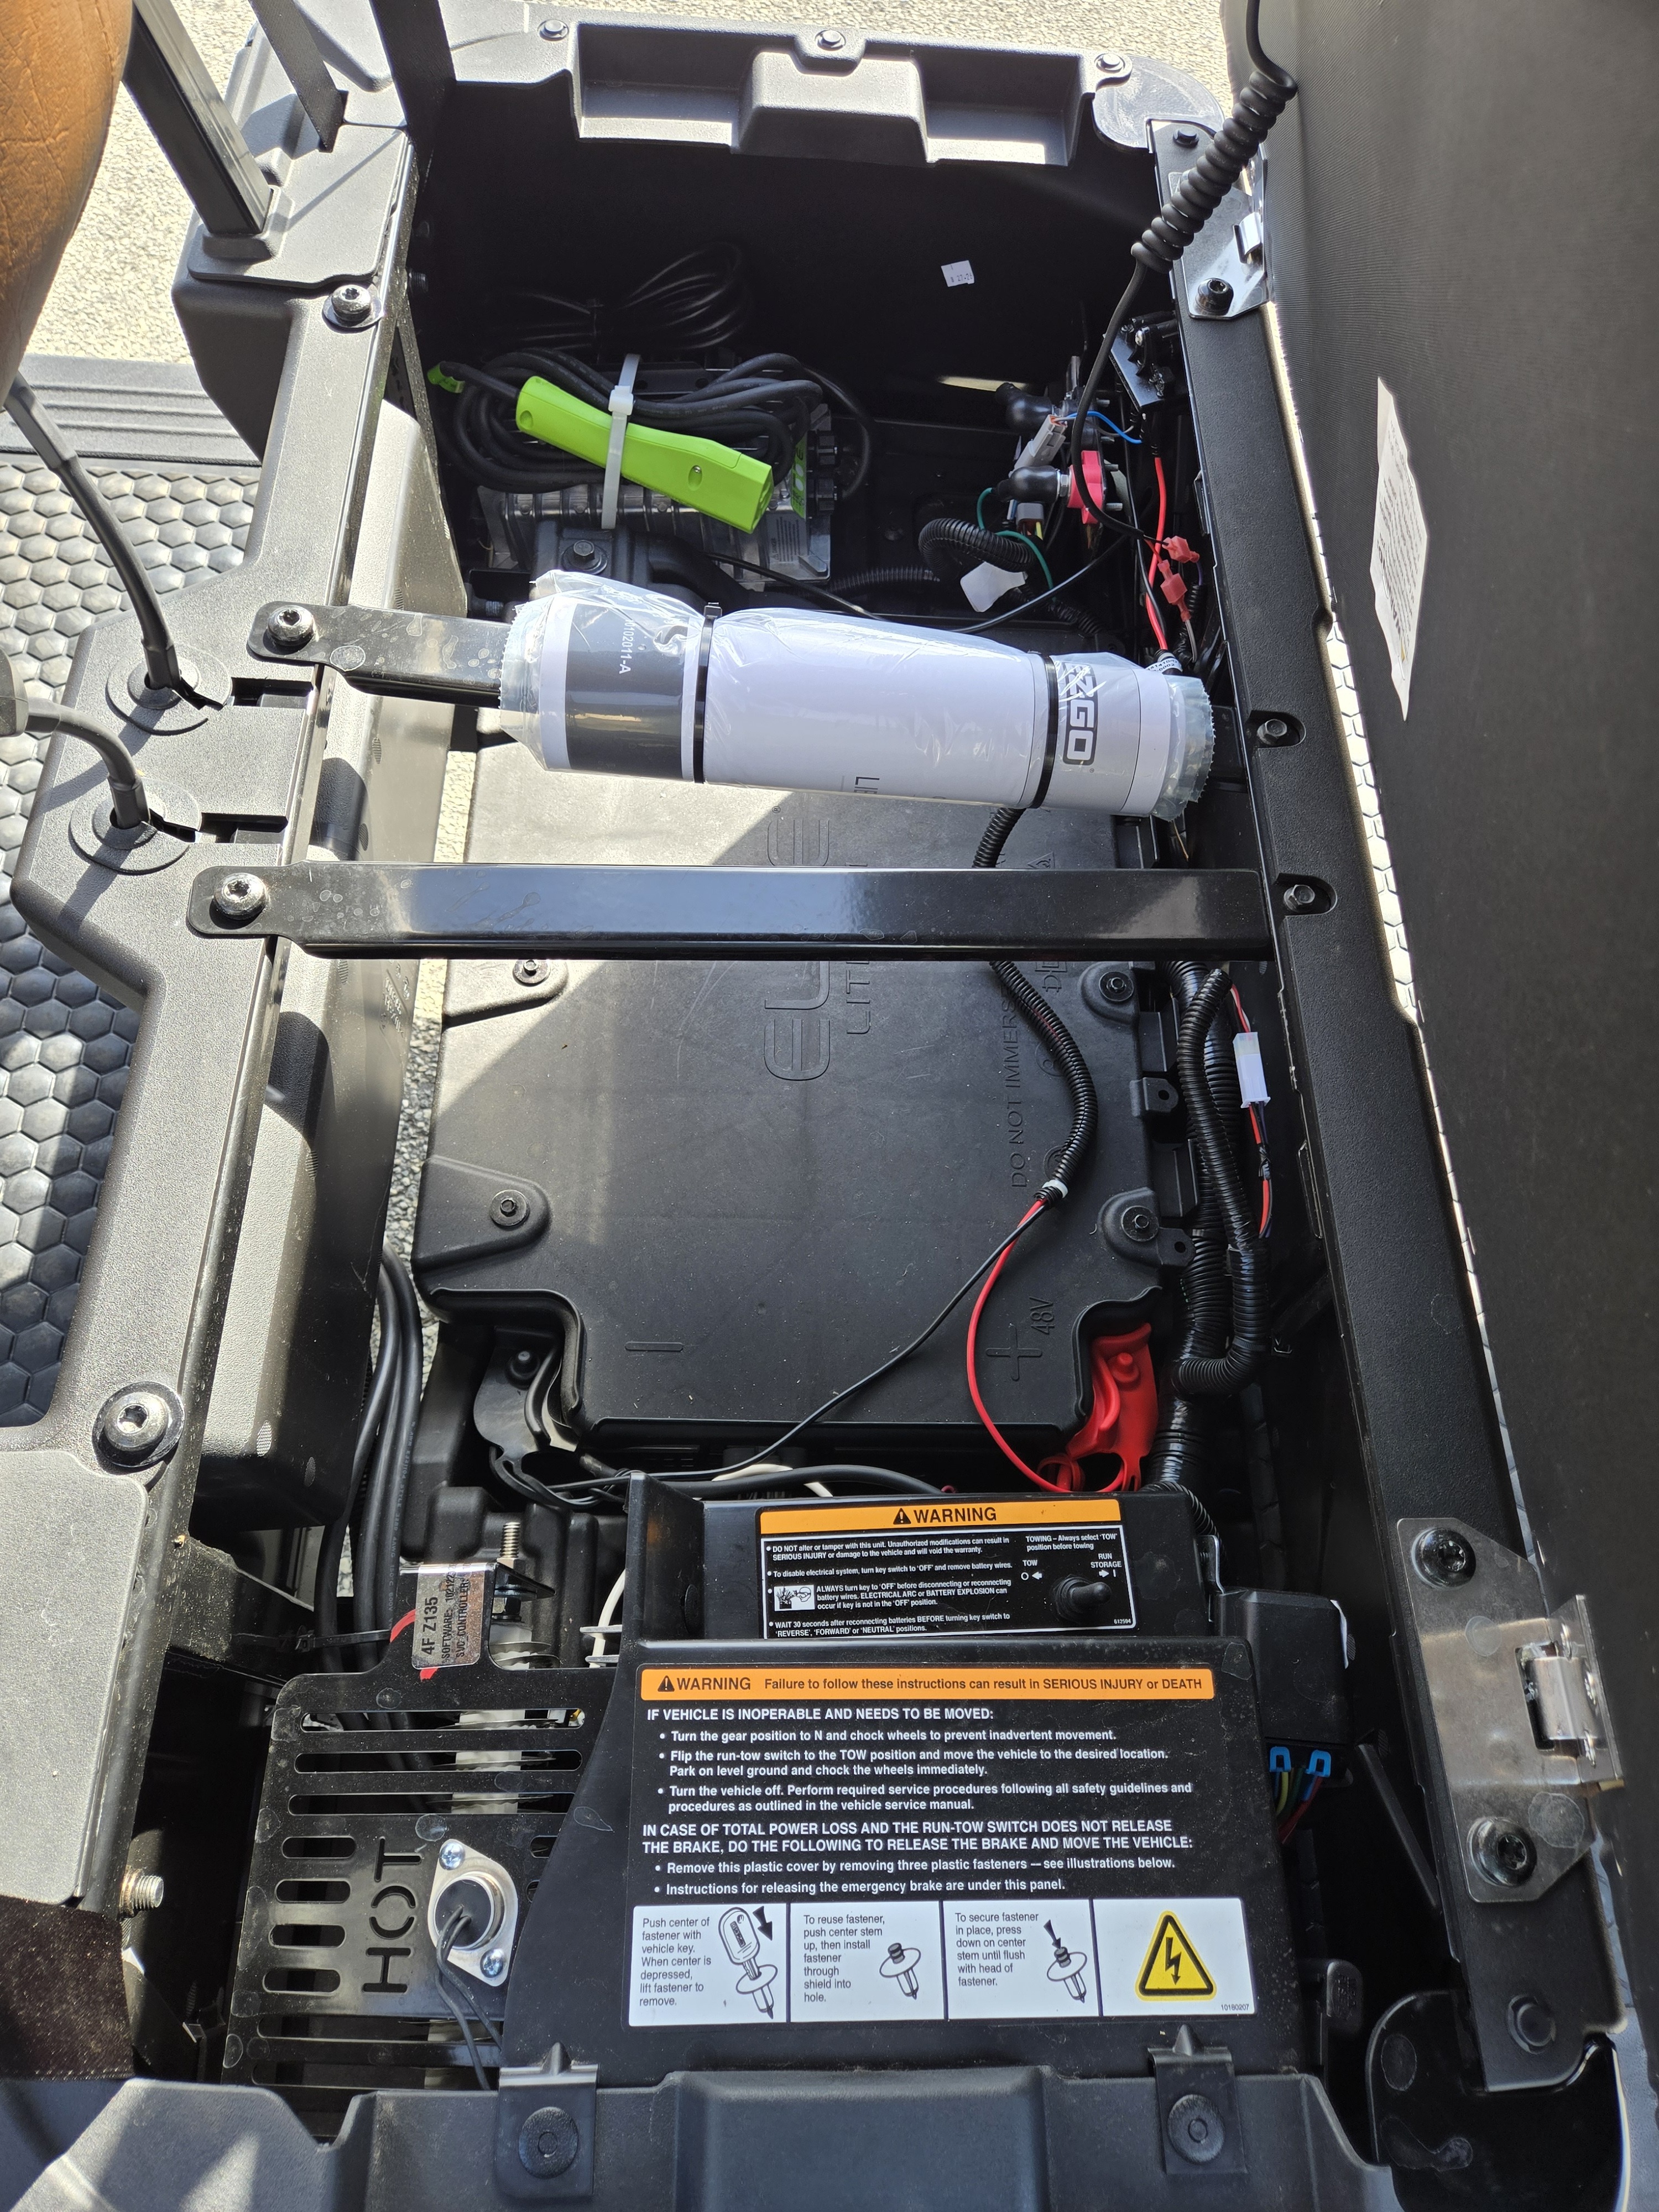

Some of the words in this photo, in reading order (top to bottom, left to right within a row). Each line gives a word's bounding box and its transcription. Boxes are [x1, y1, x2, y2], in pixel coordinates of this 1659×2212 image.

[1006, 1095, 1024, 1145] NOT
[1010, 1153, 1027, 1188] DO
[1029, 1296, 1055, 1335] 48V
[913, 1507, 997, 1524] WARNING
[888, 1540, 928, 1548] Unauthorized
[1026, 1543, 1052, 1552] position
[773, 1553, 802, 1561] SERIOUS
[817, 1594, 839, 1602] battery
[860, 1591, 901, 1599] ELECTRICAL
[957, 1587, 995, 1595] EXPLOSION
[422, 1597, 439, 1632] Z135
[421, 1638, 435, 1655] 4F
[677, 1677, 750, 1690] WARNING
[765, 1678, 805, 1689] Failure
[807, 1679, 820, 1689] to
[823, 1678, 858, 1689] follow
[861, 1678, 894, 1689] these
[897, 1678, 966, 1689] instructions
[969, 1681, 990, 1689] can
[994, 1678, 1026, 1689] result
[1029, 1678, 1040, 1689] in
[1043, 1678, 1097, 1689] SERIOUS
[1100, 1678, 1143, 1689] INJURY
[1146, 1681, 1159, 1689] or
[1162, 1678, 1202, 1689] DEATH
[647, 1709, 659, 1720] IF
[663, 1708, 718, 1720] VEHICLE
[722, 1708, 734, 1720] IS
[738, 1708, 821, 1720] INOPERABLE
[825, 1708, 852, 1719] AND
[855, 1708, 899, 1720] NEEDS
[902, 1708, 920, 1719] TO
[924, 1708, 941, 1719] BE
[945, 1708, 993, 1719] MOVED:
[671, 1730, 697, 1741] Turn
[700, 1730, 718, 1741] the
[721, 1733, 747, 1744] gear
[750, 1730, 796, 1744] position
[799, 1730, 811, 1741] to
[815, 1730, 822, 1740] N
[826, 1730, 847, 1741] and
[850, 1730, 884, 1740] chock
[887, 1729, 927, 1740] wheels
[930, 1730, 941, 1740] to
[944, 1730, 987, 1743] prevent
[989, 1729, 1053, 1740] inadvertent
[1055, 1730, 1117, 1740] movement.
[670, 1765, 696, 1776] Park
[698, 1767, 713, 1776] on
[717, 1765, 743, 1776] level
[747, 1765, 787, 1778] ground
[791, 1765, 812, 1775] and
[816, 1764, 850, 1775] chock
[853, 1764, 871, 1775] the
[874, 1764, 914, 1775] wheels
[917, 1764, 988, 1777] immediately.
[669, 1801, 735, 1814] procedures
[738, 1802, 752, 1811] as
[755, 1799, 802, 1811] outlined
[806, 1799, 816, 1811] in
[819, 1799, 838, 1811] the
[841, 1799, 881, 1810] vehicle
[885, 1799, 927, 1810] service
[930, 1798, 974, 1809] manual.
[666, 1882, 738, 1895] Instructions
[741, 1882, 758, 1893] for
[761, 1881, 816, 1895] releasing
[819, 1881, 838, 1892] the
[841, 1882, 906, 1895] emergency
[910, 1880, 942, 1891] brake
[946, 1882, 964, 1891] are
[968, 1879, 1001, 1891] under
[1004, 1879, 1026, 1890] this
[1030, 1878, 1065, 1892] panel.
[361, 1836, 424, 1994] HOT
[643, 1918, 666, 1928] Push
[669, 1917, 698, 1927] center
[701, 1916, 709, 1927] of
[642, 1931, 680, 1941] fastener
[683, 1929, 701, 1940] with
[641, 1943, 675, 1954] vehicle
[677, 1943, 695, 1955] key.
[641, 1957, 669, 1966] When
[671, 1956, 701, 1966] center
[703, 1955, 711, 1965] is
[640, 1969, 692, 1982] depressed,
[640, 1983, 651, 1993] lift
[654, 1983, 692, 1993] fastener
[695, 1982, 704, 1992] to
[639, 1997, 676, 2006] remove.
